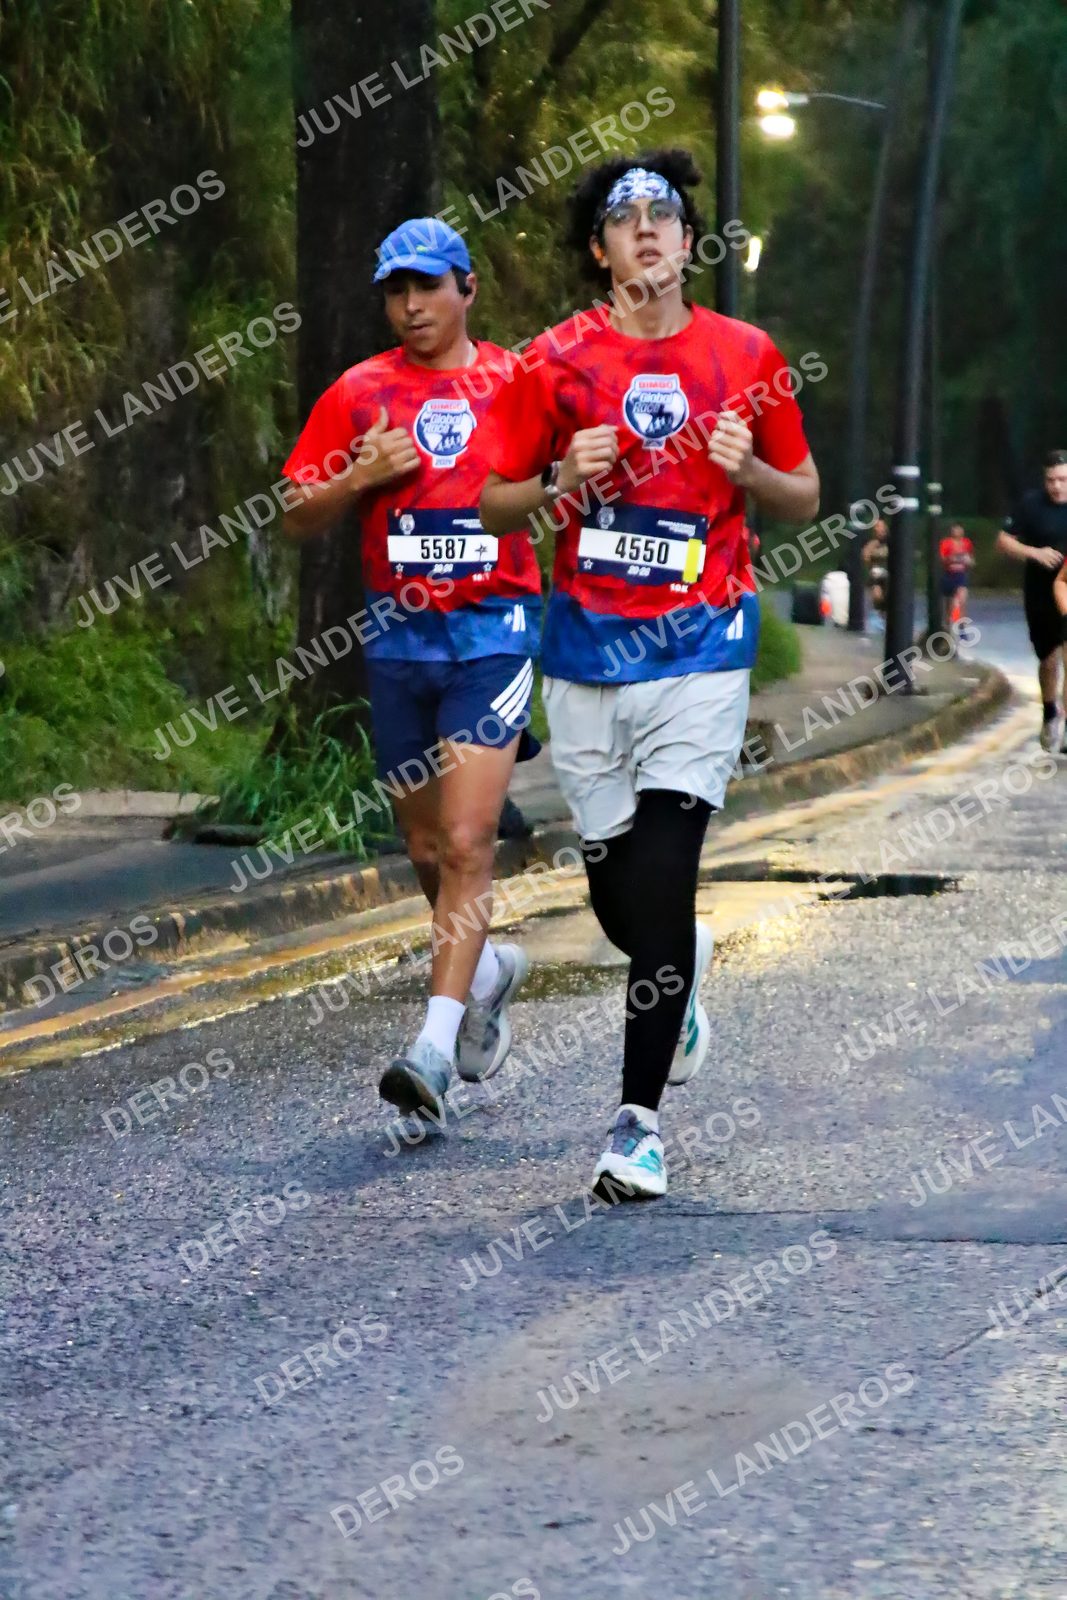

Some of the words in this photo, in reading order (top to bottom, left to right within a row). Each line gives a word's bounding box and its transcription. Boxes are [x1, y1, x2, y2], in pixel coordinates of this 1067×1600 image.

[430, 411, 463, 424] Global
[421, 538, 466, 559] 5587
[615, 535, 670, 565] 4550
